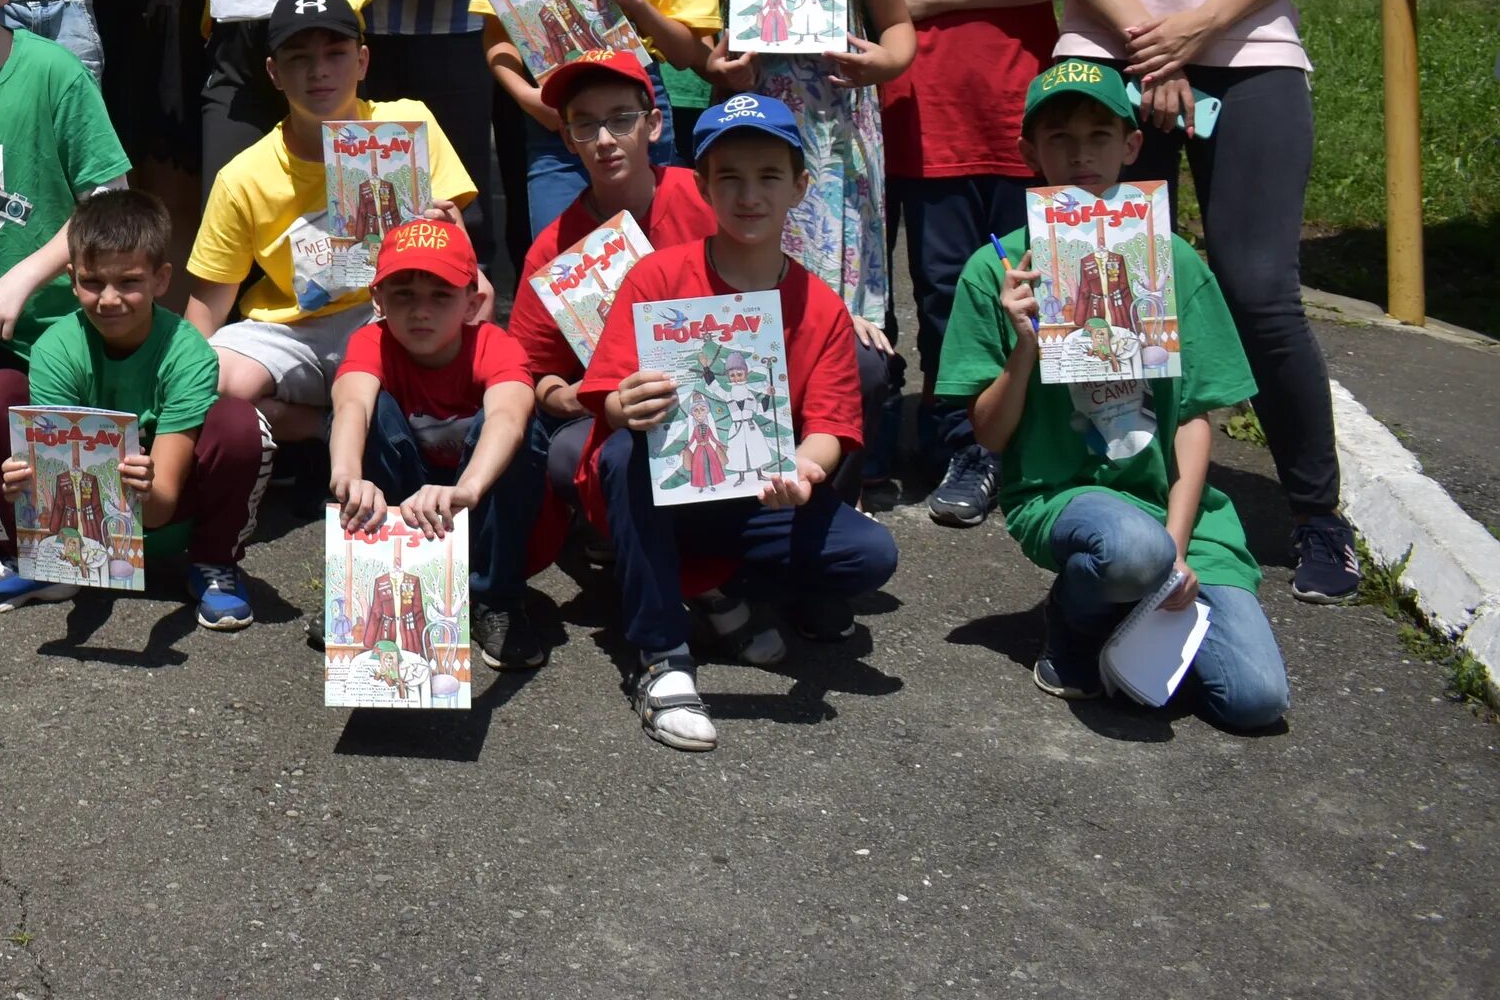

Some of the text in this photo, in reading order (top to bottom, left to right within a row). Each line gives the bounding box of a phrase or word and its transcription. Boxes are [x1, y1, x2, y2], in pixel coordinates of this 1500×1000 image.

[1041, 62, 1103, 81] MEDIA
[1043, 71, 1101, 90] CAMP
[717, 110, 767, 123] TOYOTA
[394, 223, 450, 242] MEDIA
[395, 235, 447, 252] CAMP
[1091, 379, 1138, 405] CAMP
